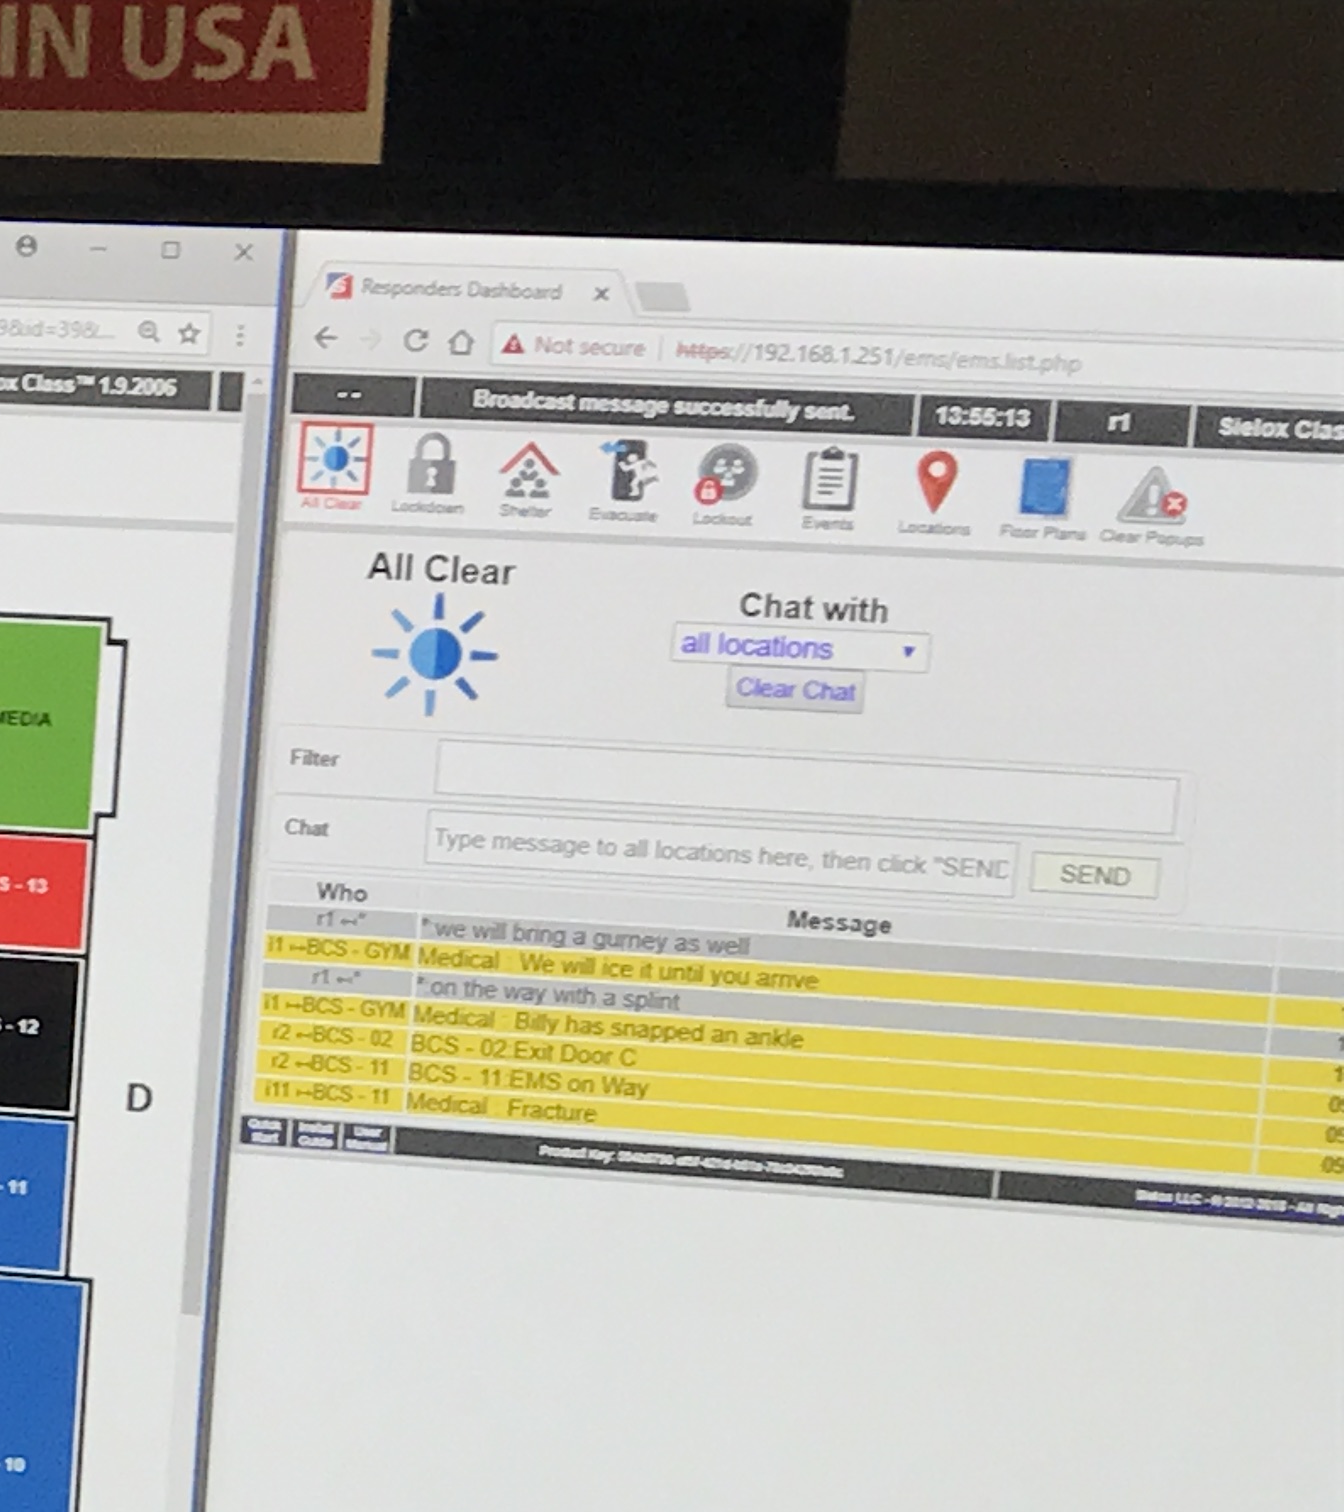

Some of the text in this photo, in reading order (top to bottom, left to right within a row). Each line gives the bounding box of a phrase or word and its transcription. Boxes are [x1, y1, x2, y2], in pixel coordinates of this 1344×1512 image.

[122, 2, 317, 82] USA
[361, 277, 563, 302] Responders Dashboard
[534, 335, 646, 357] Not secure
[472, 387, 855, 425] Broadcast message successfully sent.
[935, 404, 1031, 428] 13:55:13
[367, 550, 517, 587] All Clear
[740, 590, 888, 624] Chat with
[680, 631, 834, 661] all locations
[736, 675, 857, 703] Clear Chat
[289, 746, 340, 769] Filter
[284, 816, 330, 838] Chat
[435, 826, 487, 853] Type
[491, 834, 591, 860] message
[596, 837, 618, 858] to
[622, 839, 649, 859] all
[654, 839, 753, 865] locations
[757, 845, 814, 872] here,
[821, 849, 872, 873] then
[877, 853, 928, 876] click
[26, 876, 49, 895] 13
[1060, 862, 1131, 888] SEND
[317, 881, 368, 904] Who
[434, 921, 751, 956] we will bring a gurney as well
[787, 909, 892, 939] Message
[418, 946, 820, 992] Medical We will ice it until you arrive
[430, 978, 681, 1012] on the way with a splint
[17, 1017, 40, 1035] 12
[413, 1004, 805, 1050] Medical Billy has snapped an ankle
[411, 1032, 460, 1057] BCS
[559, 1042, 614, 1066] Door
[618, 1046, 637, 1068] C
[408, 1061, 458, 1085] BCS
[567, 1076, 595, 1094] on
[601, 1074, 650, 1101] Way
[126, 1082, 153, 1113] D
[406, 1091, 598, 1124] Medical Fracture
[7, 1178, 28, 1196] 11
